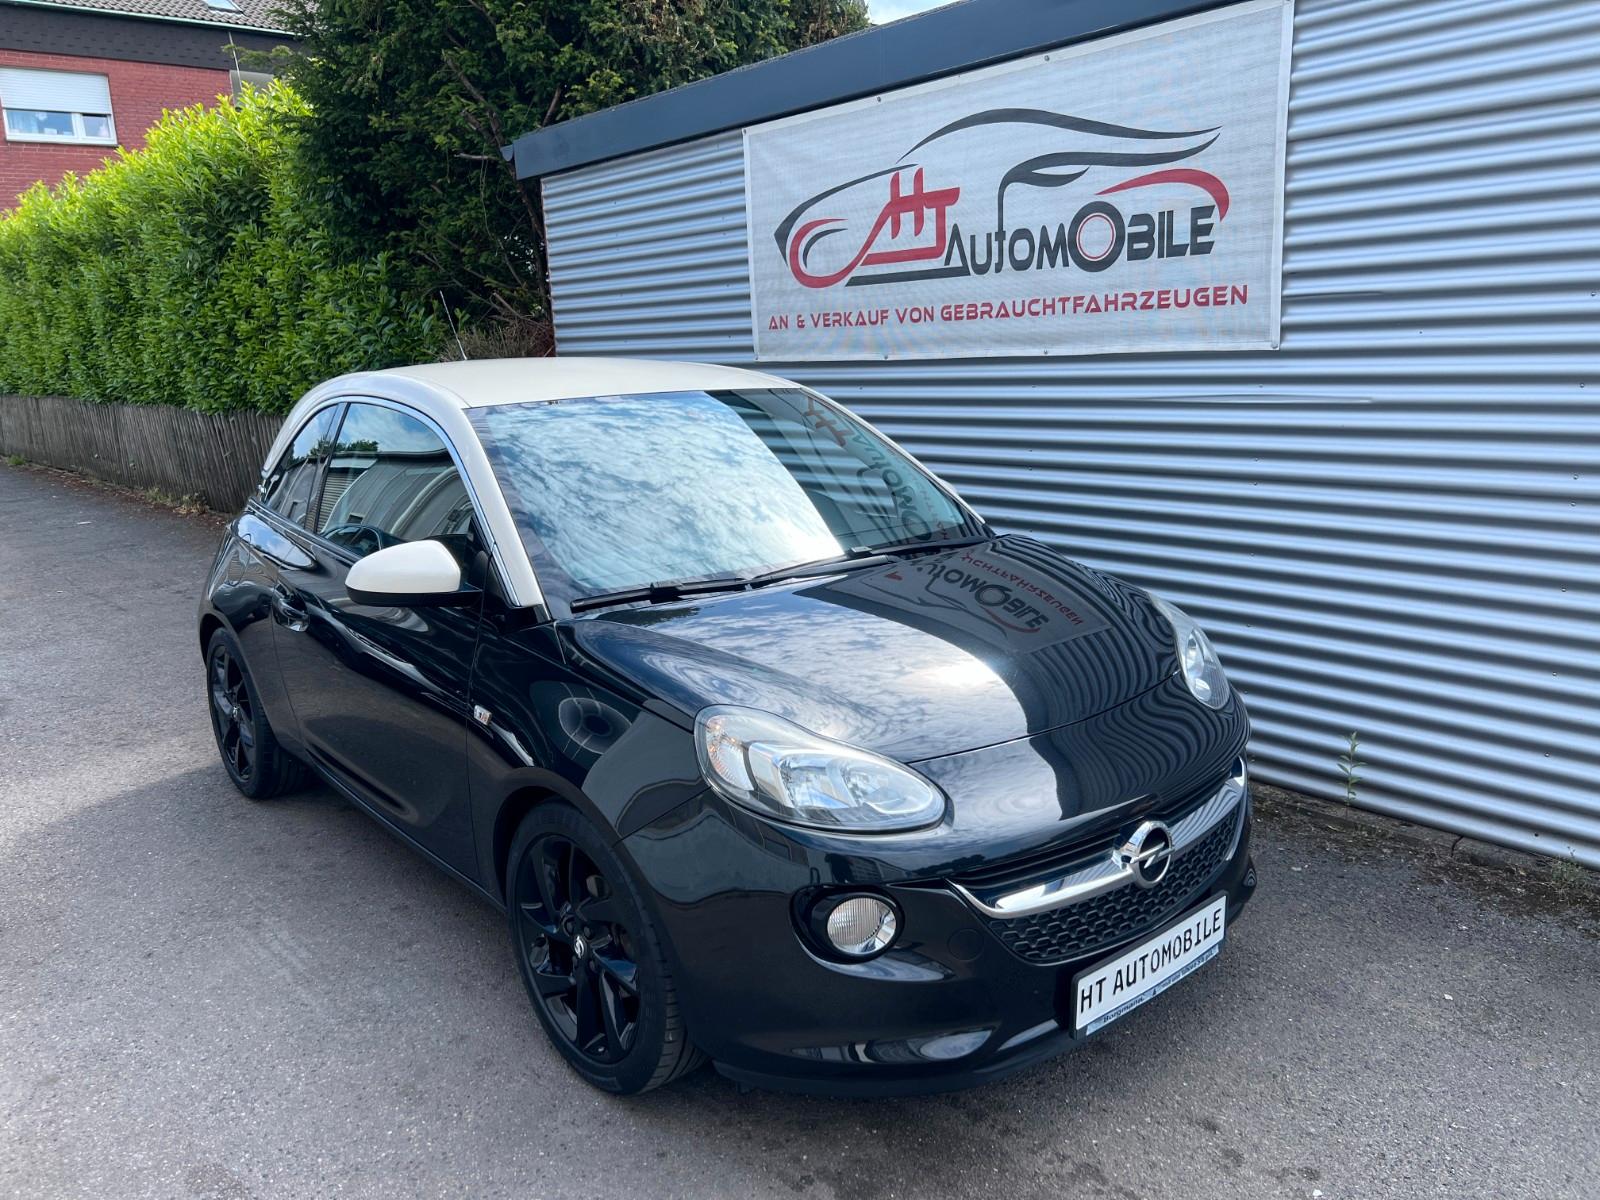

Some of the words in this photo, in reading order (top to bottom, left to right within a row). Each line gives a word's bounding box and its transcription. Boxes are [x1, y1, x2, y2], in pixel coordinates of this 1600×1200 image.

[944, 200, 1216, 275] AUTOMOBILE
[768, 315, 789, 330] AN
[796, 314, 806, 329] &
[810, 309, 889, 328] VERKAUF
[895, 306, 935, 324] VON
[940, 285, 1249, 321] GEBRAUCHTFAHRZEUGEN
[1081, 977, 1107, 1014] HT
[1112, 908, 1222, 996] AUTOMOBILE
